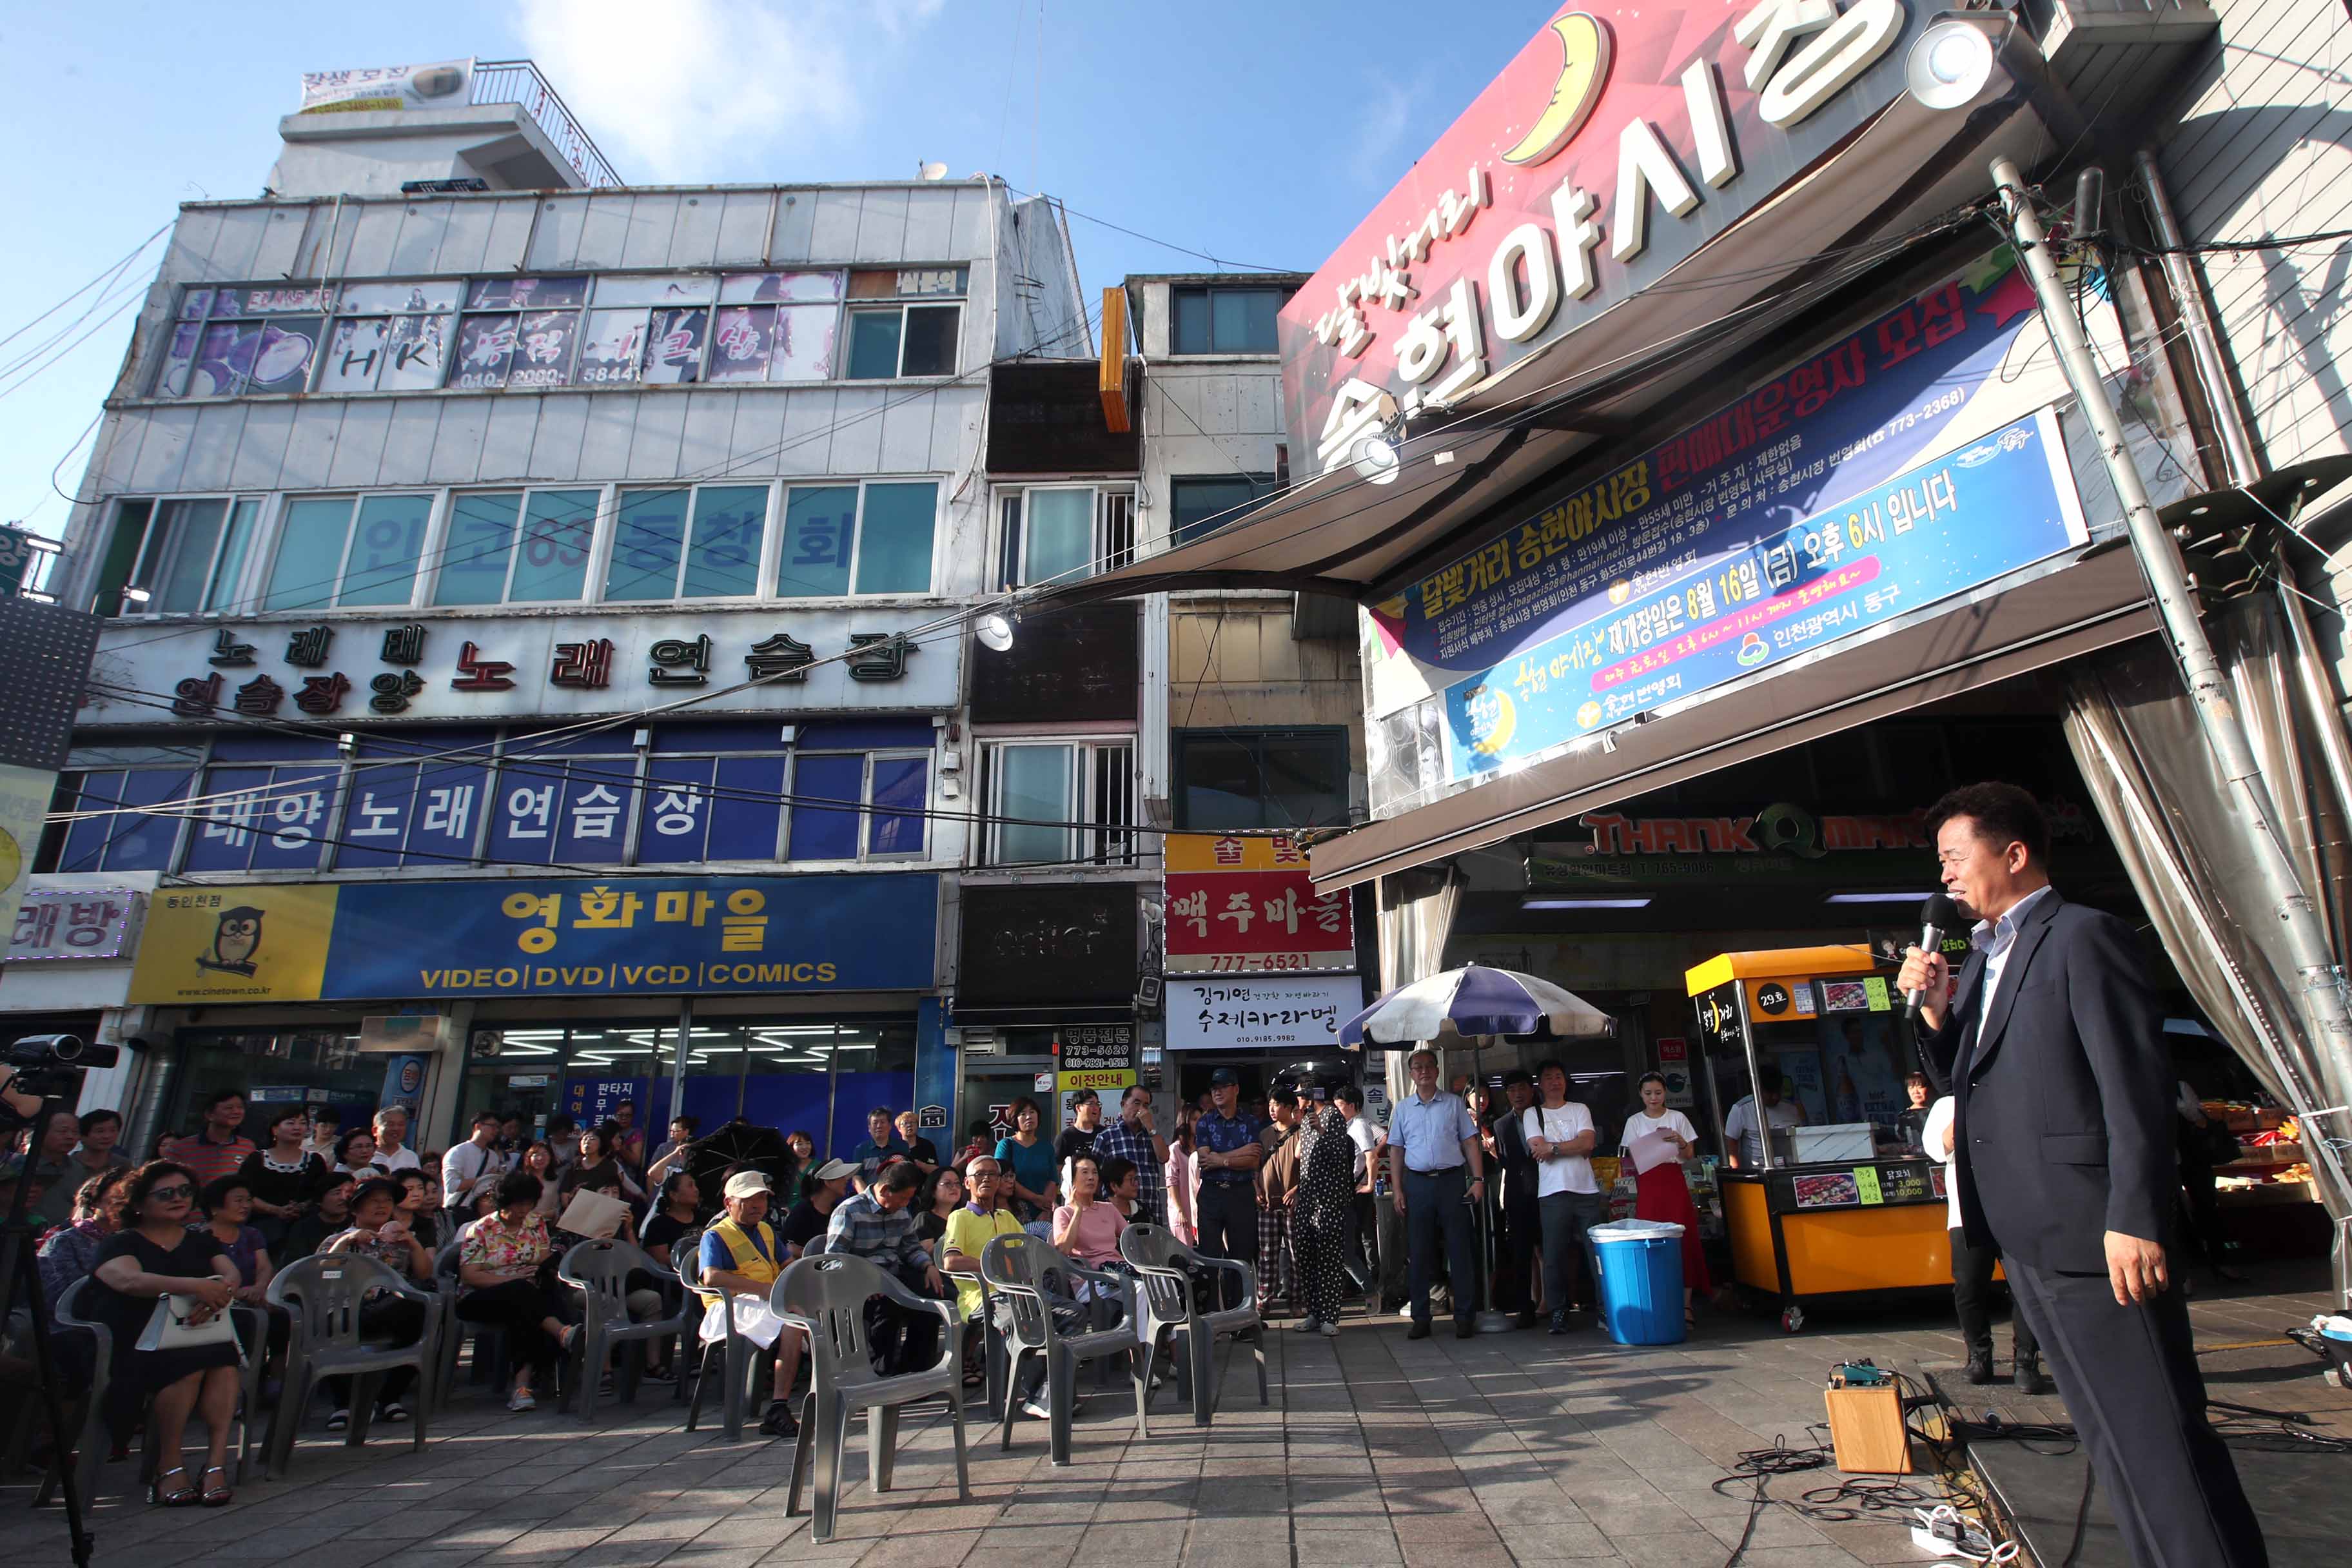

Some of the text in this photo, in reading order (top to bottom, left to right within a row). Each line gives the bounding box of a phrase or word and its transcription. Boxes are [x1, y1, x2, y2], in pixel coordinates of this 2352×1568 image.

[1421, 279, 1966, 620] 달빛거리 송현야시장 판매대운영자 모집
[1778, 458, 1825, 494] 송현시장
[1489, 590, 1505, 607] 상시
[1508, 572, 1540, 597] 모집대상
[1609, 526, 1627, 545] 이상
[1674, 491, 1694, 511] 미만
[1756, 434, 1802, 468] 제한없음
[1607, 594, 1685, 655] 재개장일은
[1686, 578, 1717, 620] 8월
[1718, 558, 1761, 605] 16일
[1763, 540, 1798, 589] (금)
[1803, 520, 1845, 569] 오후
[1847, 501, 1886, 549] 6시
[1886, 468, 1957, 537] 입니다
[1499, 610, 1531, 633] 송현시장
[1579, 575, 1598, 593] 동구
[1772, 583, 1901, 649] 인천광역시 동구
[451, 632, 922, 692] 노래연습장
[1580, 812, 1759, 854] THANK
[166, 894, 222, 908] 동인천점
[502, 886, 769, 954] 영화마을
[1173, 887, 1344, 938] 맥주마을
[1210, 954, 1310, 970] 777-6521
[707, 962, 837, 984] COMICS
[1193, 986, 1251, 1005] 김기연
[1760, 991, 1787, 1007] 29호
[1198, 1005, 1337, 1033] 수제카라멜
[1237, 1035, 1295, 1043] 010.9185.9982
[1065, 1044, 1130, 1056] 773-5629
[1064, 1057, 1129, 1068] 010-9861-1515
[598, 1083, 634, 1096] 판타지
[1070, 1072, 1122, 1088] 이전안내
[925, 1116, 941, 1126] 1-1
[1896, 1188, 1923, 1197] 10,000
[1897, 1179, 1921, 1188] 3,000
